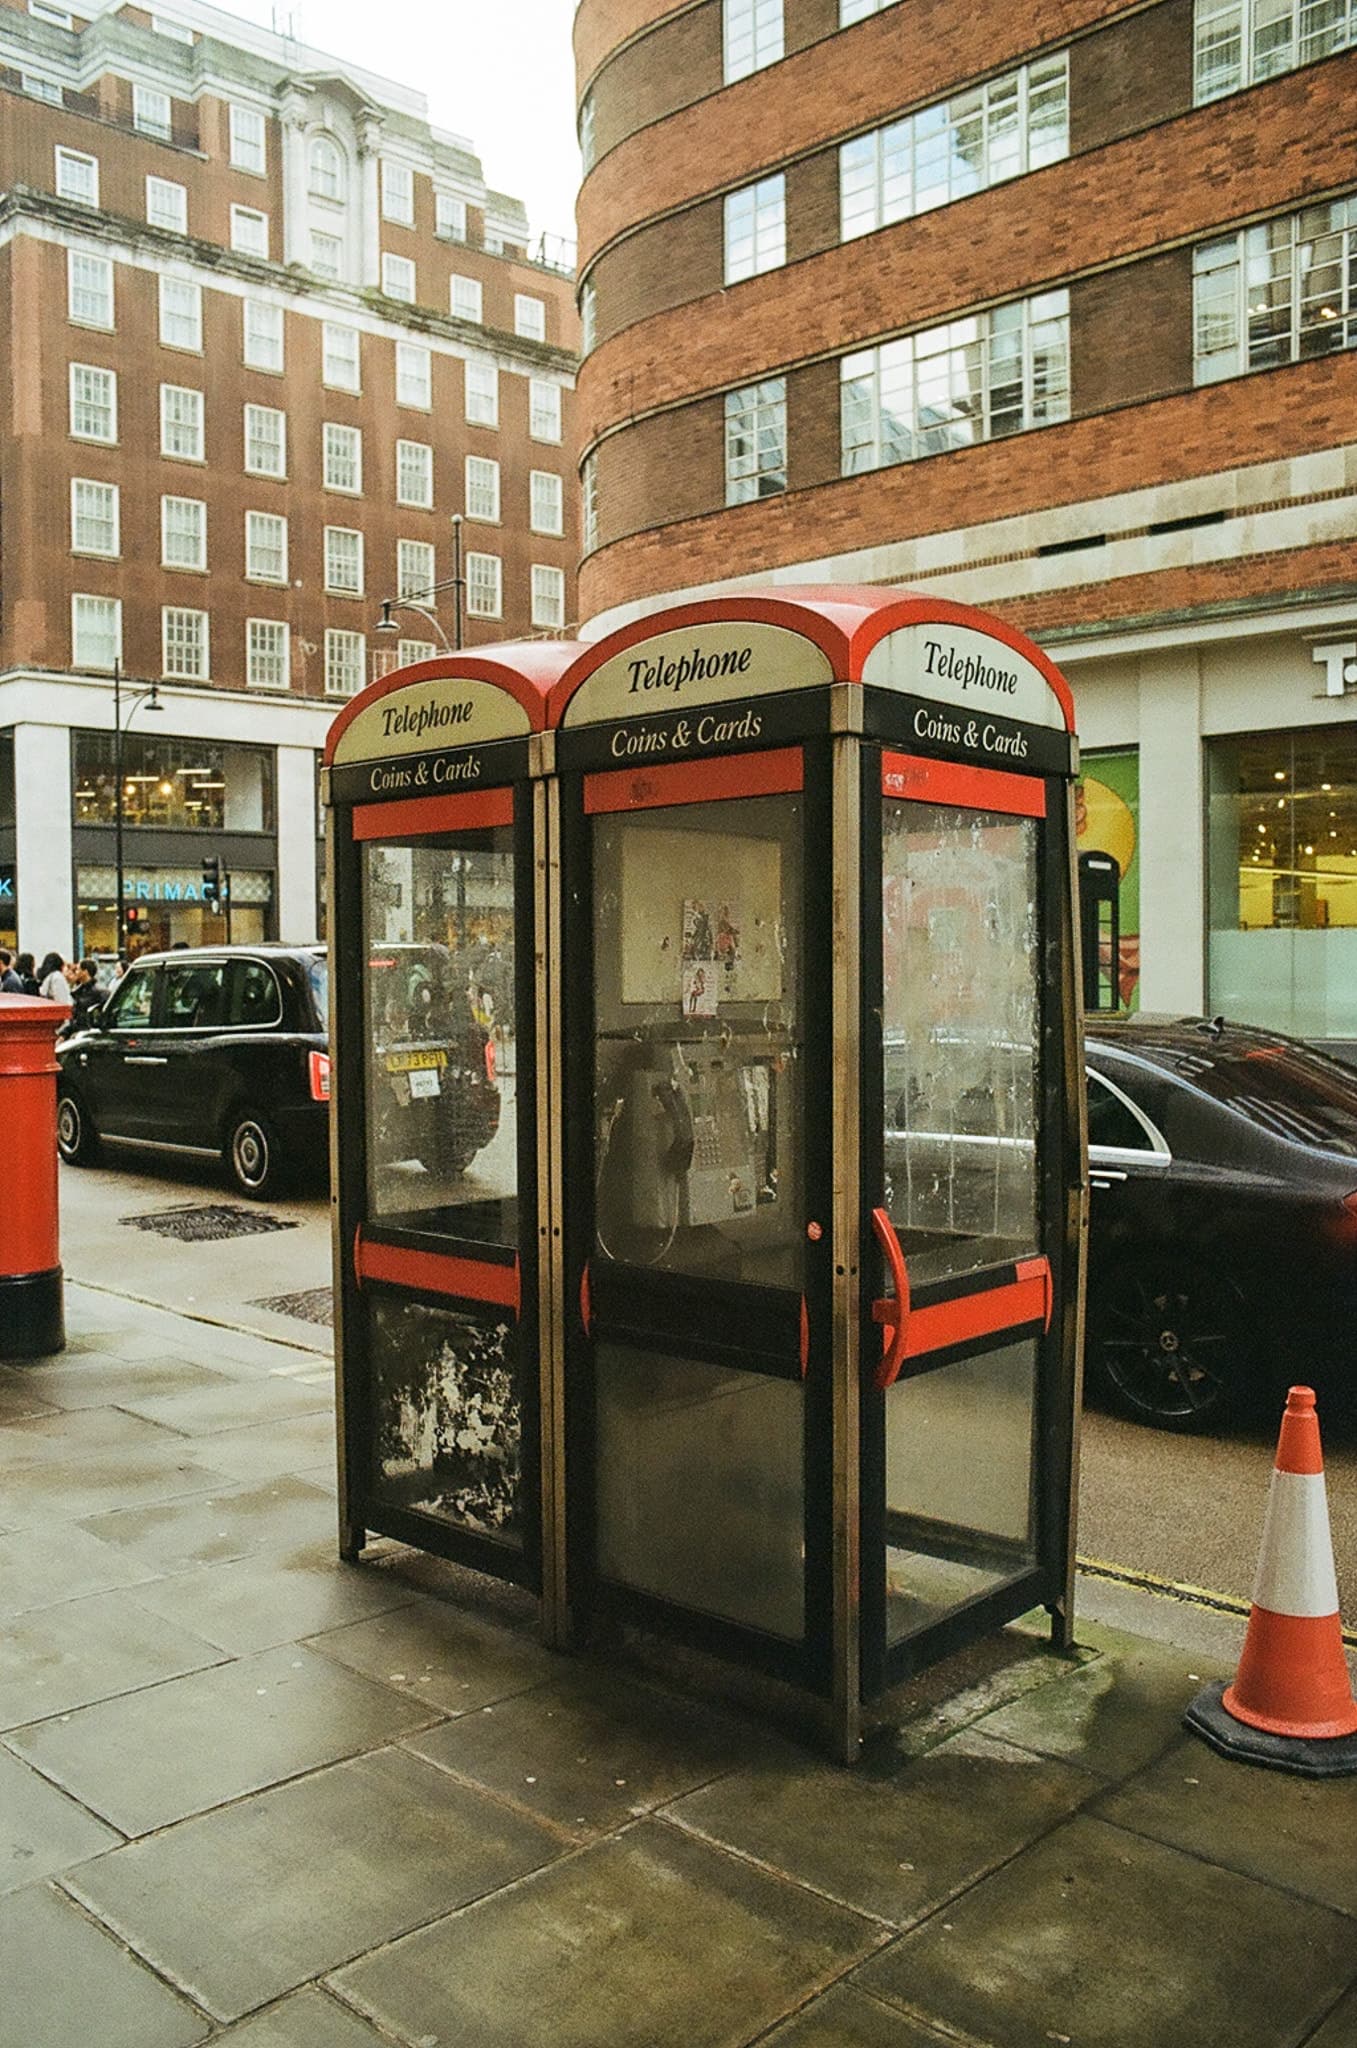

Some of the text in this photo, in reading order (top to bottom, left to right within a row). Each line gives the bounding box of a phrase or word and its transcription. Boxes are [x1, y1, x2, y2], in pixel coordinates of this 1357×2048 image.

[628, 648, 752, 693] Telephone
[924, 641, 1018, 694] Telephone
[382, 700, 474, 737] Telephone
[611, 710, 762, 757] Coins & Cards
[914, 709, 1028, 757] Coins & Cards
[370, 755, 481, 791] Coins & Cards
[123, 880, 228, 901] PRIMA
